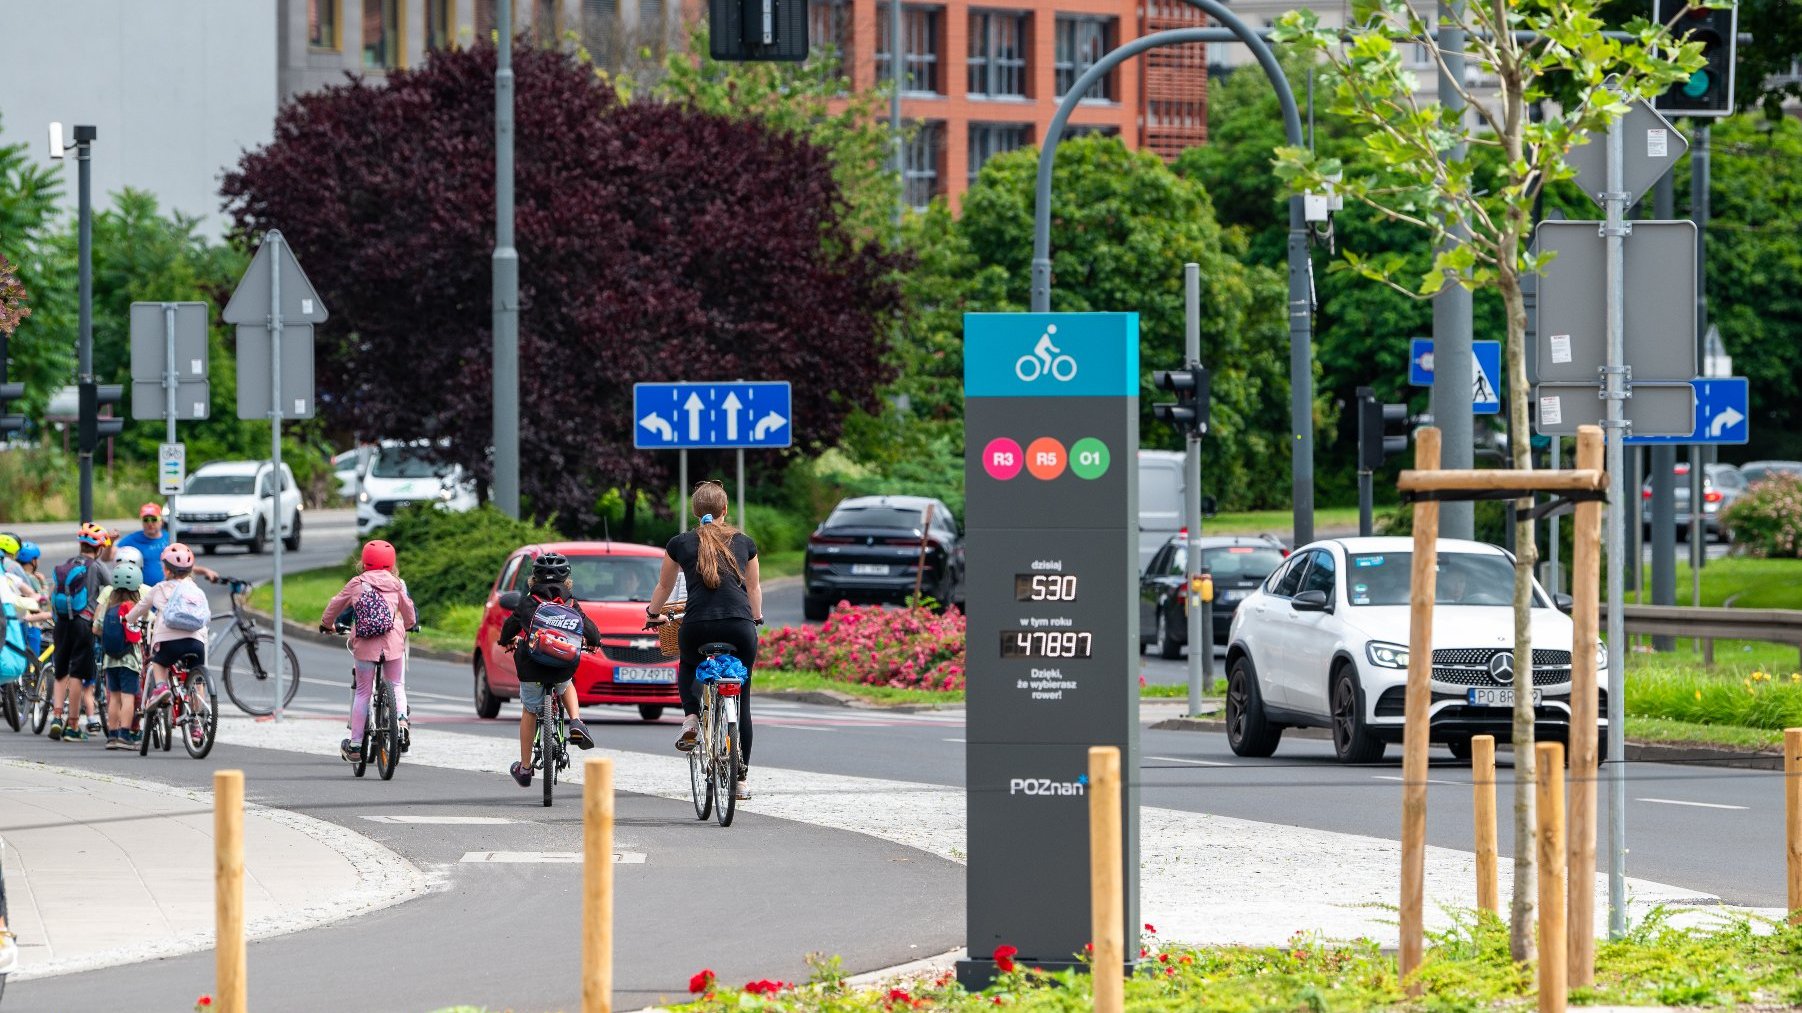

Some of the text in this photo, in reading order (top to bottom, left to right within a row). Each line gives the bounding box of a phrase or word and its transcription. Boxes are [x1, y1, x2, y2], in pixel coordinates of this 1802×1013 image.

[993, 452, 1014, 466] R3
[1036, 452, 1057, 466] R5
[1031, 560, 1062, 571] dzisiaj
[1031, 575, 1077, 601] 530
[1020, 617, 1072, 628] w tym roku
[1017, 632, 1092, 657] 47897
[622, 668, 637, 680] PO
[1031, 669, 1062, 679] Dzięki,
[1017, 679, 1077, 690] że wybierasz
[1031, 691, 1062, 699] rower!
[1478, 690, 1495, 703] PO
